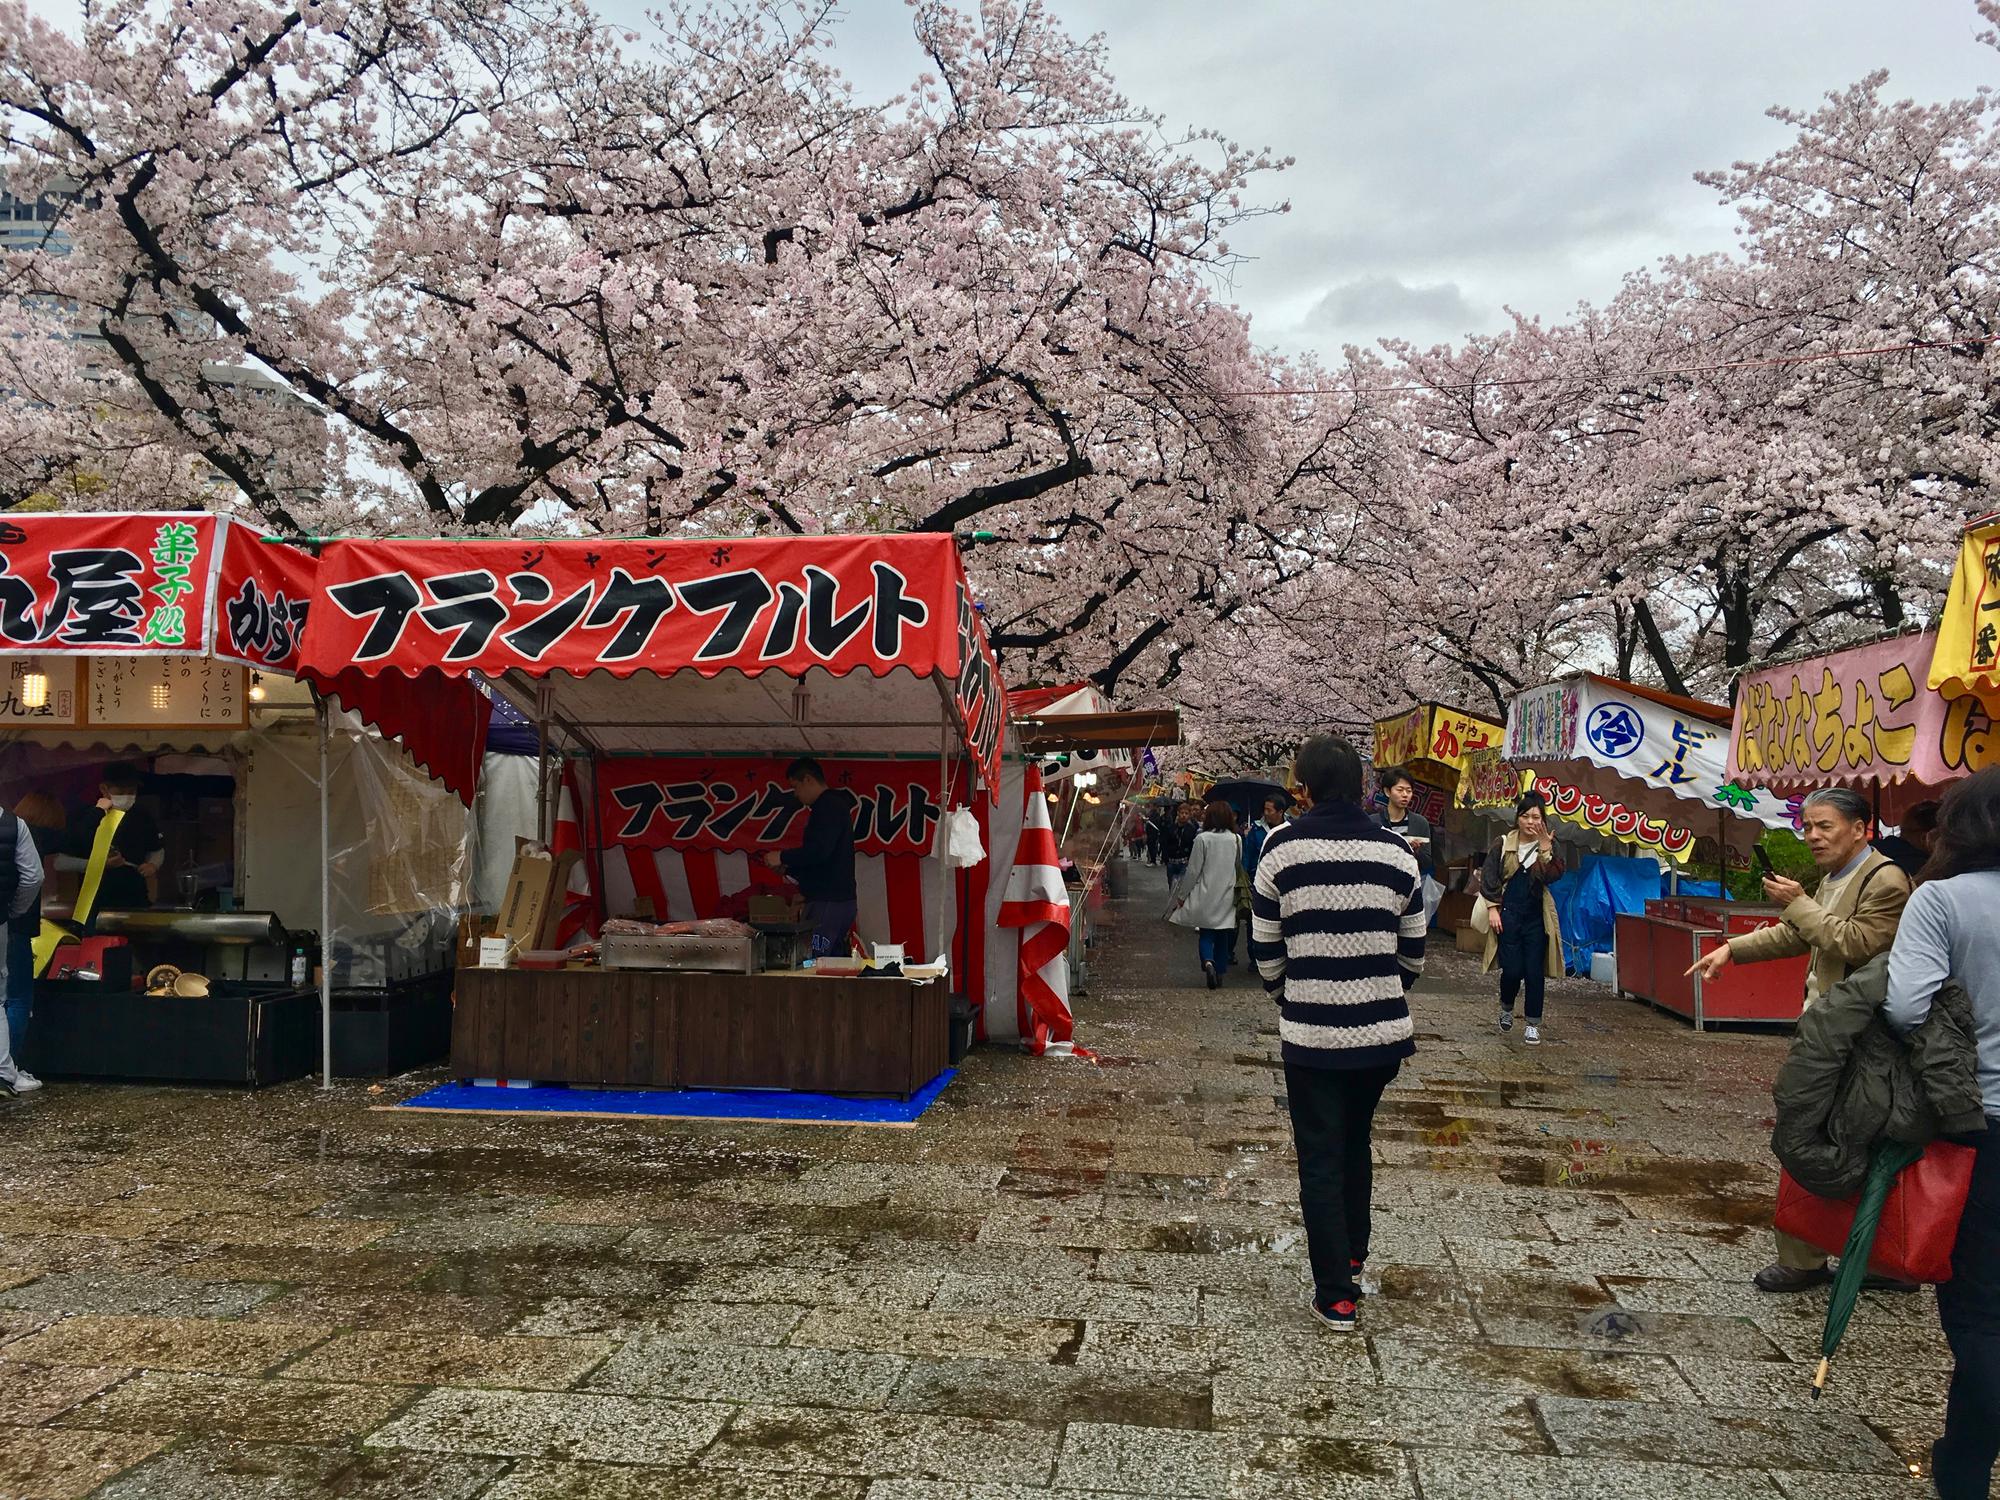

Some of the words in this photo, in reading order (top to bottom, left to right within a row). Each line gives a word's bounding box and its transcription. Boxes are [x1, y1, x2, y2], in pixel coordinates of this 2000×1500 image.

[146, 522, 198, 645] 菓子処
[519, 549, 734, 571] ジャンボ
[325, 561, 930, 662] フランクフルト
[221, 667, 232, 718] ひとつの
[1737, 662, 1916, 774] ばななちょこ
[1589, 709, 1639, 755] 冷
[1650, 718, 1717, 785] ビール
[610, 781, 942, 845] フランクルト
